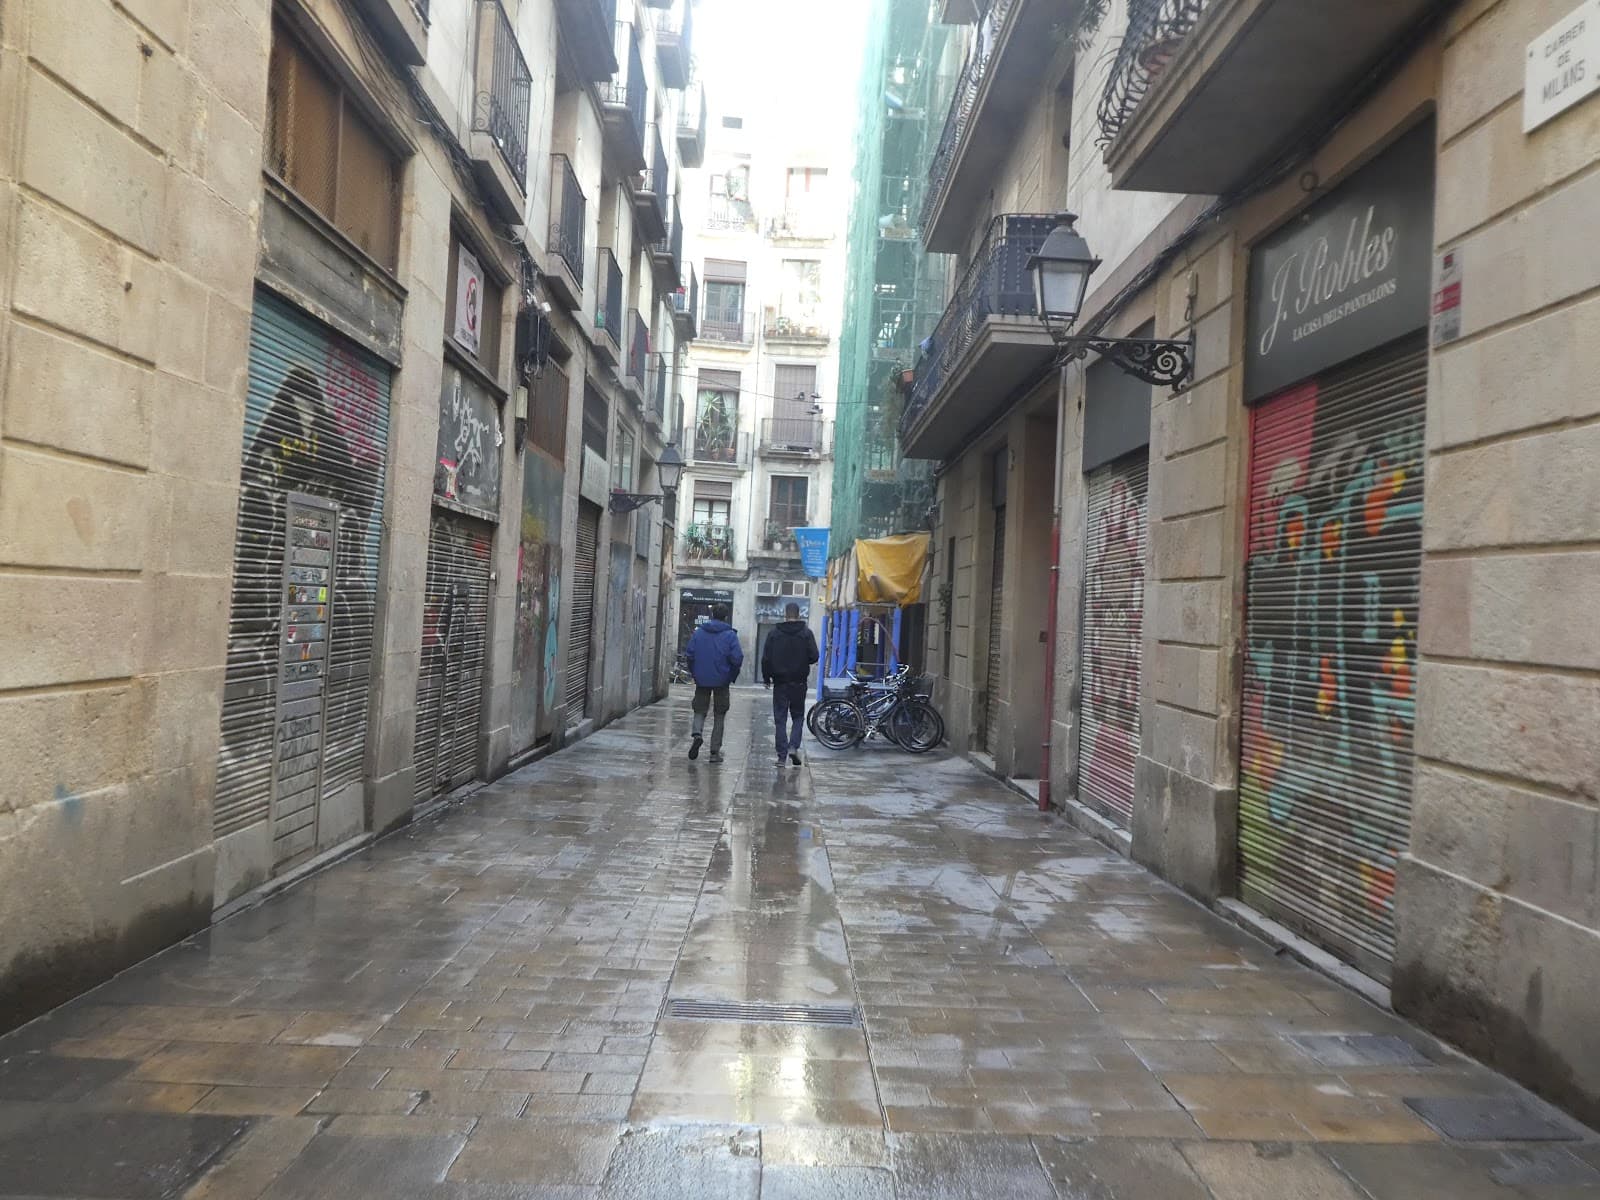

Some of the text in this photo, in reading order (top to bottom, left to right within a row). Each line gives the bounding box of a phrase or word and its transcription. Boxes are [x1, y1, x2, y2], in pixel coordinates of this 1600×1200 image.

[1544, 20, 1585, 58] CARRER
[1557, 49, 1571, 67] DE
[1542, 59, 1585, 104] MILANS
[1260, 205, 1398, 356] J. Robles
[1303, 317, 1323, 337] CASA
[1323, 308, 1344, 327] DELS
[1344, 278, 1397, 317] PANTALONS
